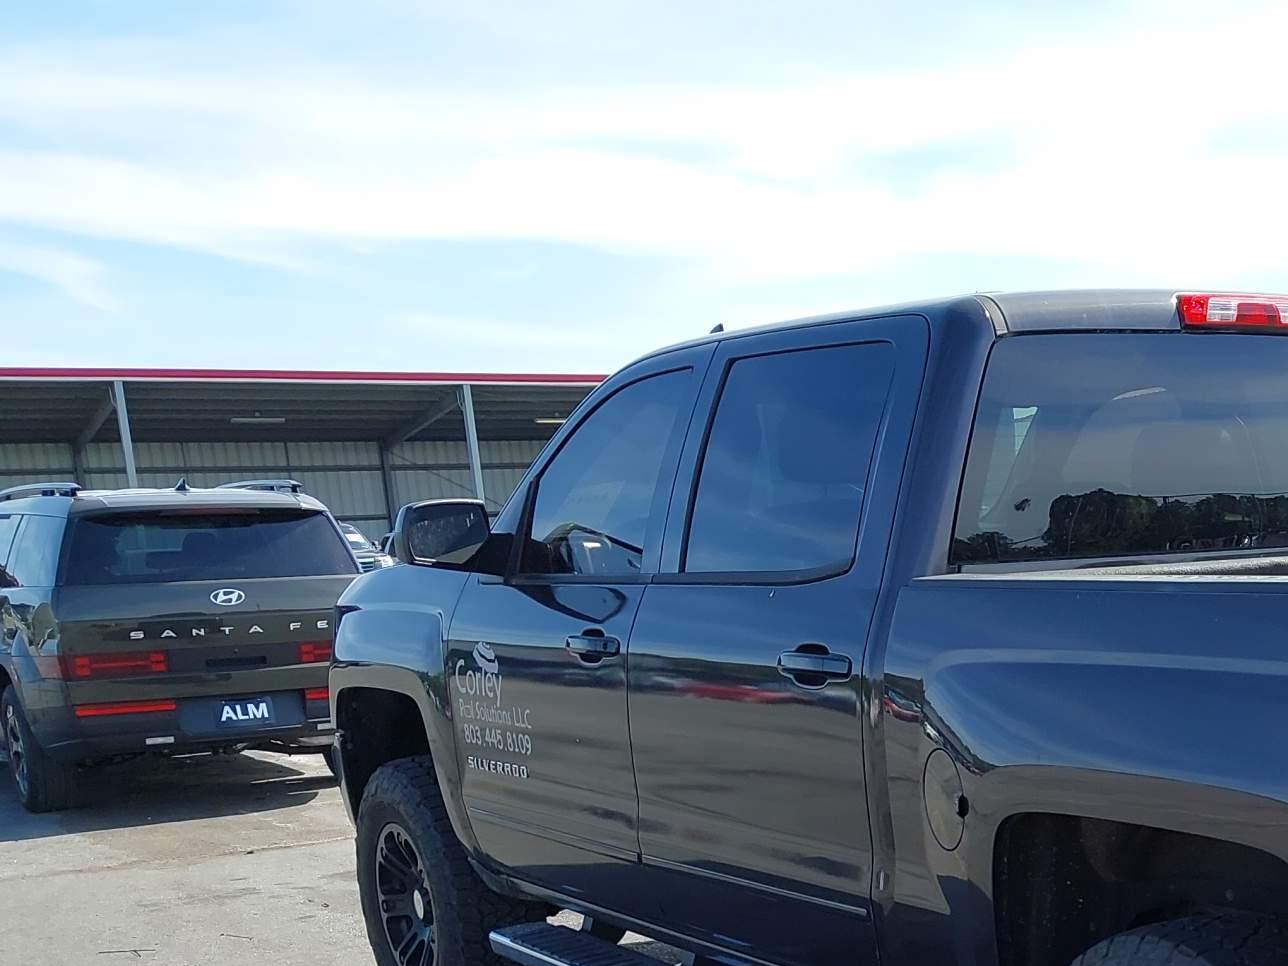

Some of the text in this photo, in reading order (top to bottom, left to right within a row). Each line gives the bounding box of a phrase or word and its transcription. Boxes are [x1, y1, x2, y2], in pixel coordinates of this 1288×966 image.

[129, 619, 329, 640] SANTA FE
[455, 658, 503, 707] Corley
[219, 701, 270, 723] ALM
[475, 701, 512, 726] Solutions
[512, 706, 533, 729] LLC
[463, 722, 532, 756] 803.445.8109
[467, 755, 528, 779] SILVERADO
